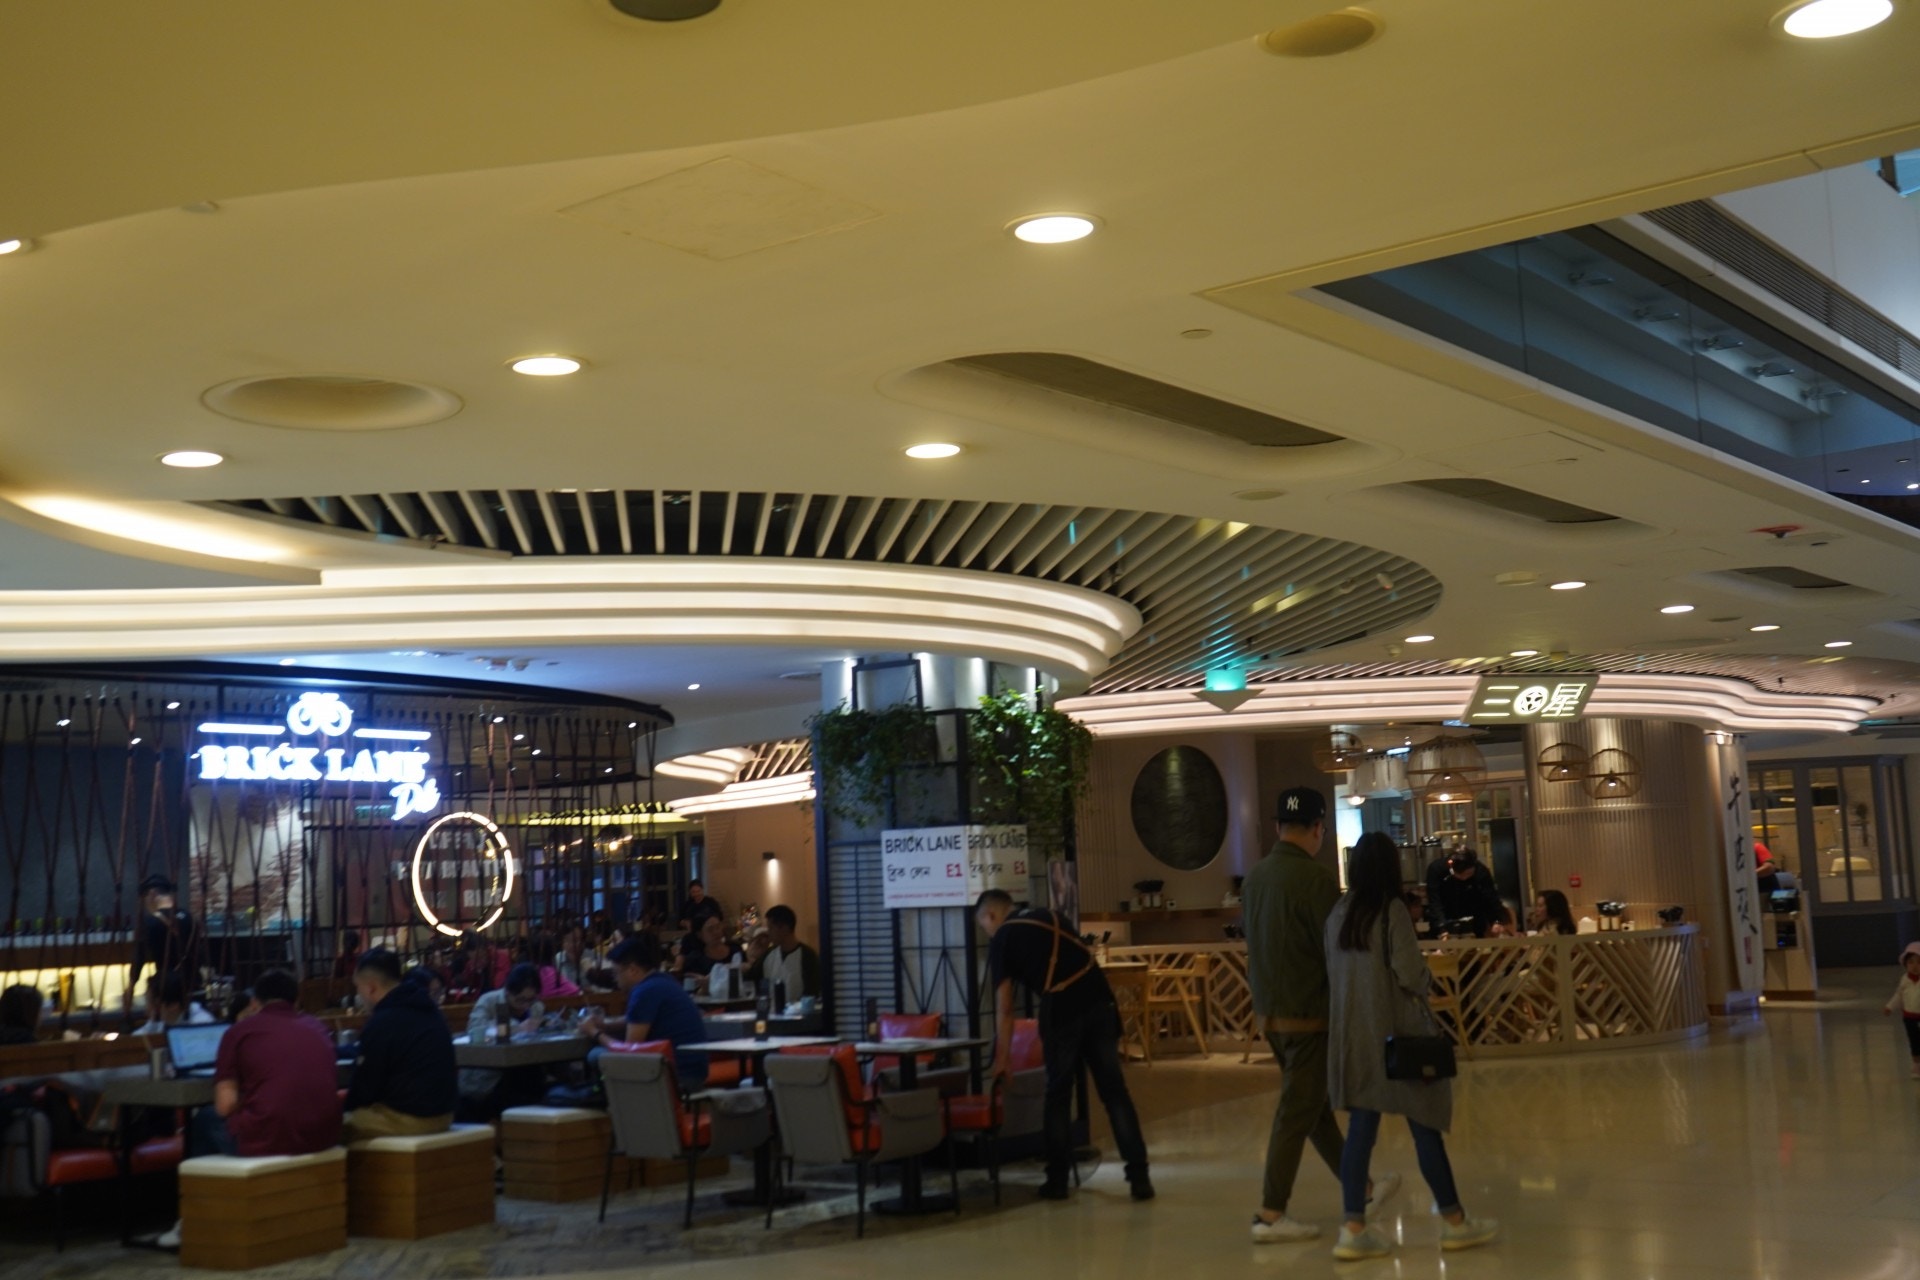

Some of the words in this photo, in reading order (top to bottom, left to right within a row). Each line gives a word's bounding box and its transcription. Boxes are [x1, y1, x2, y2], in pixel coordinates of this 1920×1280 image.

[198, 744, 323, 780] BRICK
[324, 749, 430, 783] LANE
[1286, 795, 1299, 811] NY
[885, 835, 924, 853] BRICK
[927, 834, 962, 851] LANE
[968, 833, 997, 849] BRICK
[946, 862, 963, 878] E1
[1014, 860, 1026, 876] E1
